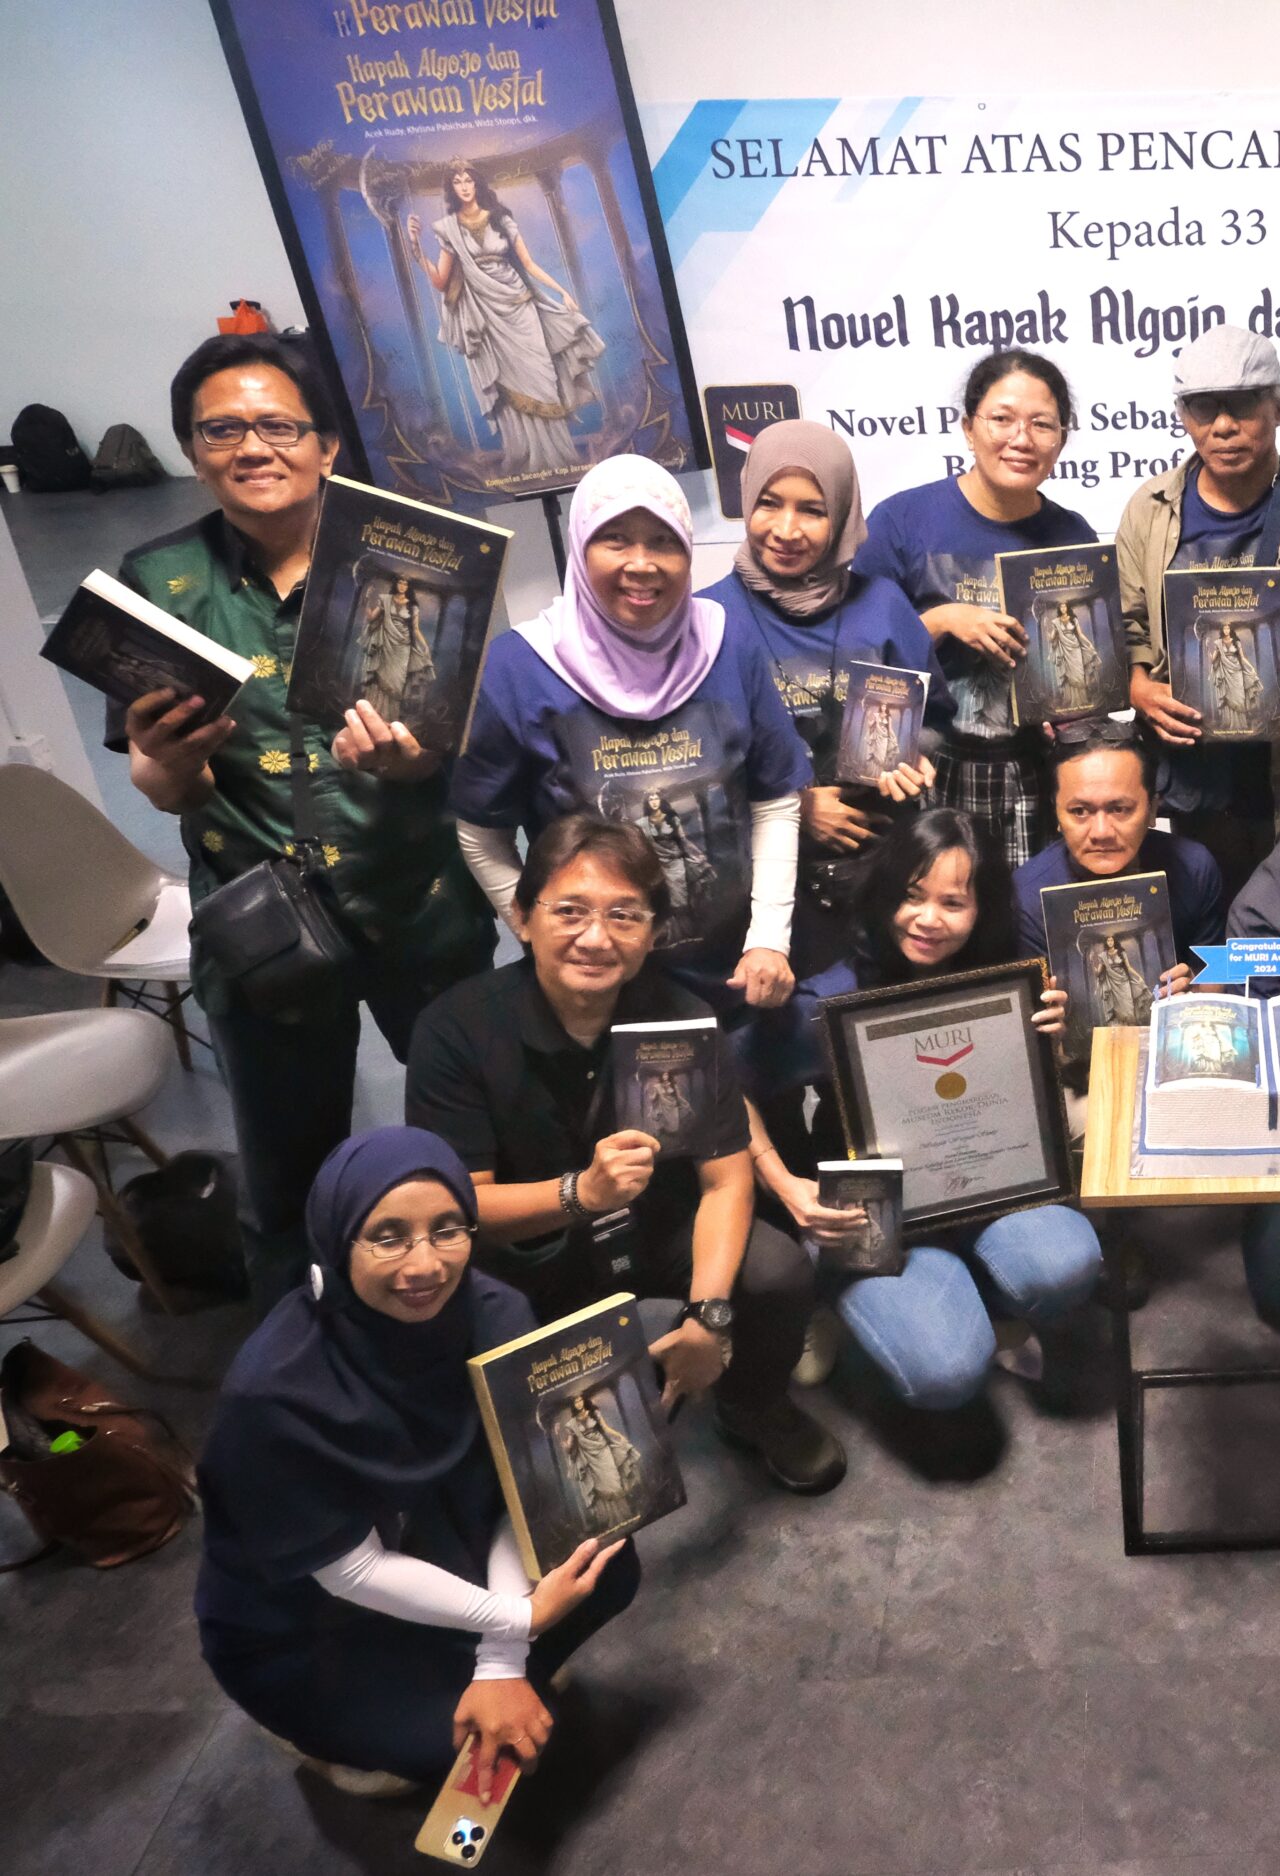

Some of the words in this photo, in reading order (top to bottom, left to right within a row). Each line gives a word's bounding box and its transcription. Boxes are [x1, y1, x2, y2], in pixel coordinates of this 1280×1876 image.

[347, 50, 411, 87] Kapak
[417, 47, 482, 81] Algojo
[486, 43, 521, 71] dan
[336, 81, 464, 124] Perawan
[468, 69, 546, 116] Vestal
[710, 134, 947, 179] SELAMAT
[961, 132, 1082, 174] ATAS
[1047, 206, 1206, 261] Kepada
[1221, 208, 1267, 245] 33
[783, 294, 910, 352] Novel
[930, 289, 1069, 351] Kapak
[722, 401, 786, 421] MURI
[826, 406, 927, 437] Novel
[1091, 400, 1187, 438] Sebag
[1109, 448, 1185, 478] Prof
[592, 749, 658, 771] Perawan
[1229, 953, 1243, 962] for
[1244, 953, 1269, 961] MURI
[1254, 964, 1276, 973] 2024
[914, 1027, 972, 1053] MURI
